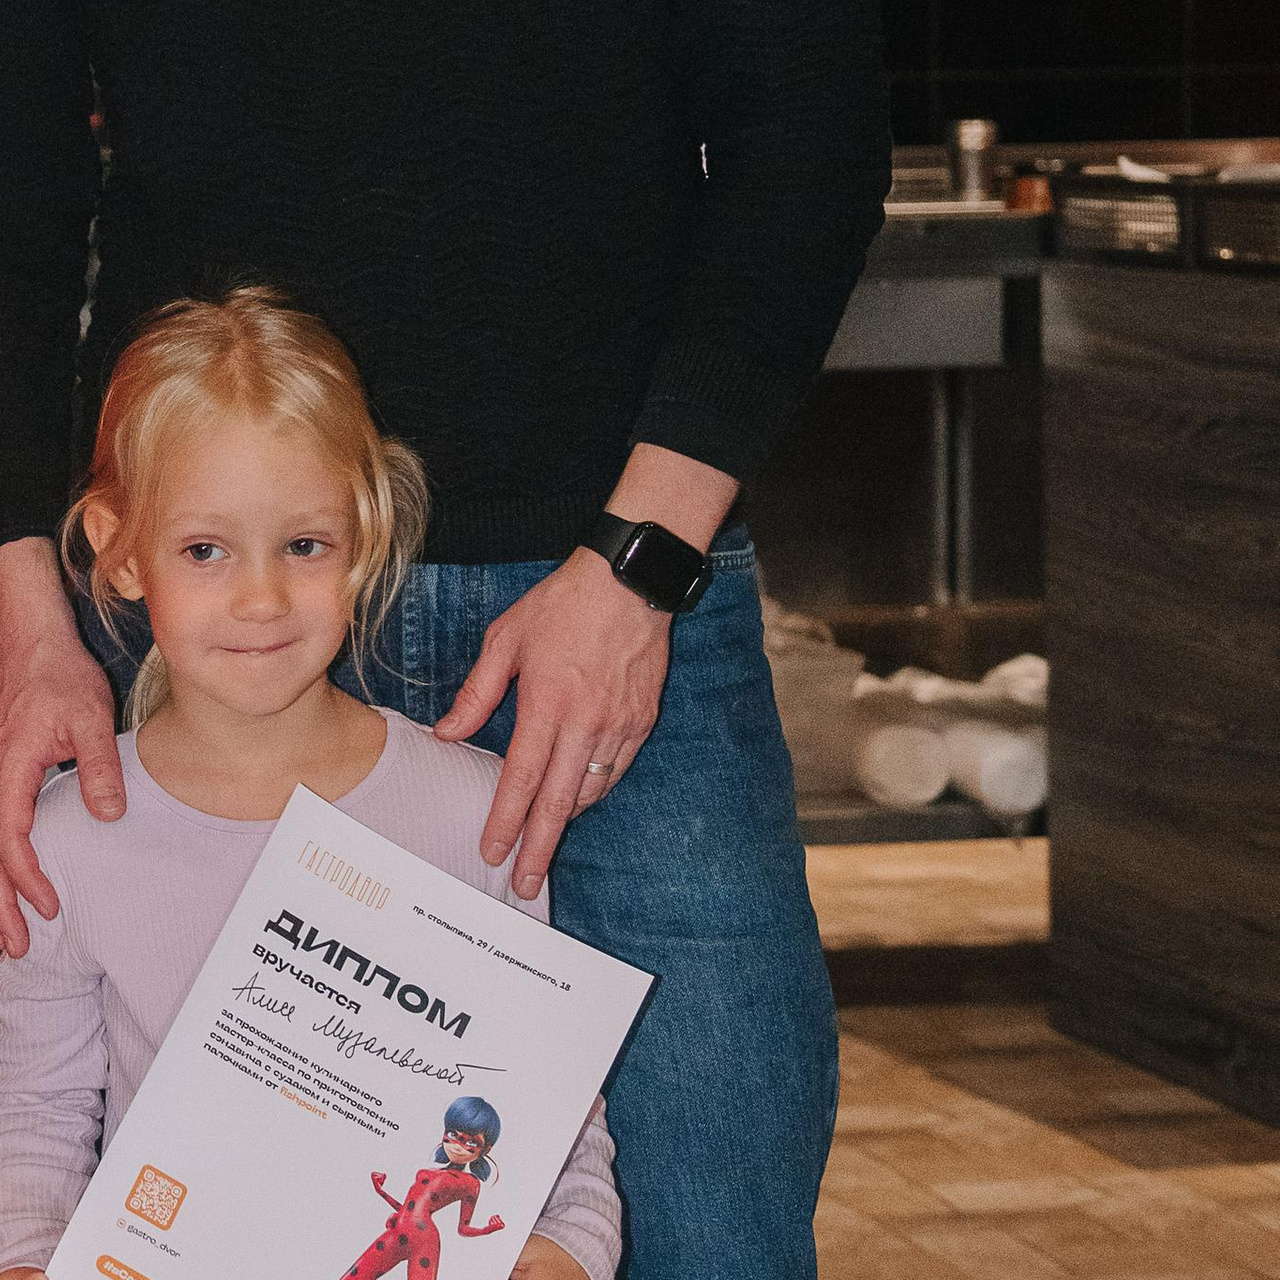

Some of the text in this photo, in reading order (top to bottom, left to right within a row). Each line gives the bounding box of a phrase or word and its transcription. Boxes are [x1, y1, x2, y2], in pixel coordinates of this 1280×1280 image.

[297, 840, 392, 911] ГАСТРОДВОР
[252, 943, 362, 1015] вручается
[263, 909, 472, 1039] ДИПЛОМ
[412, 905, 426, 917] пр.
[427, 913, 475, 944] столыпина,
[476, 939, 488, 949] 29
[493, 949, 558, 987] дзержинского,
[559, 981, 572, 992] 18
[232, 971, 296, 1022] Алисе
[203, 1042, 328, 1120] палочками от fishpoint
[210, 1032, 386, 1138] сэндвича с судаком и сырными
[215, 1020, 400, 1131] мастер-класса по приготовлению
[221, 1009, 382, 1106] за прохождение кулинарного
[127, 1224, 181, 1258] gastro_dvor
